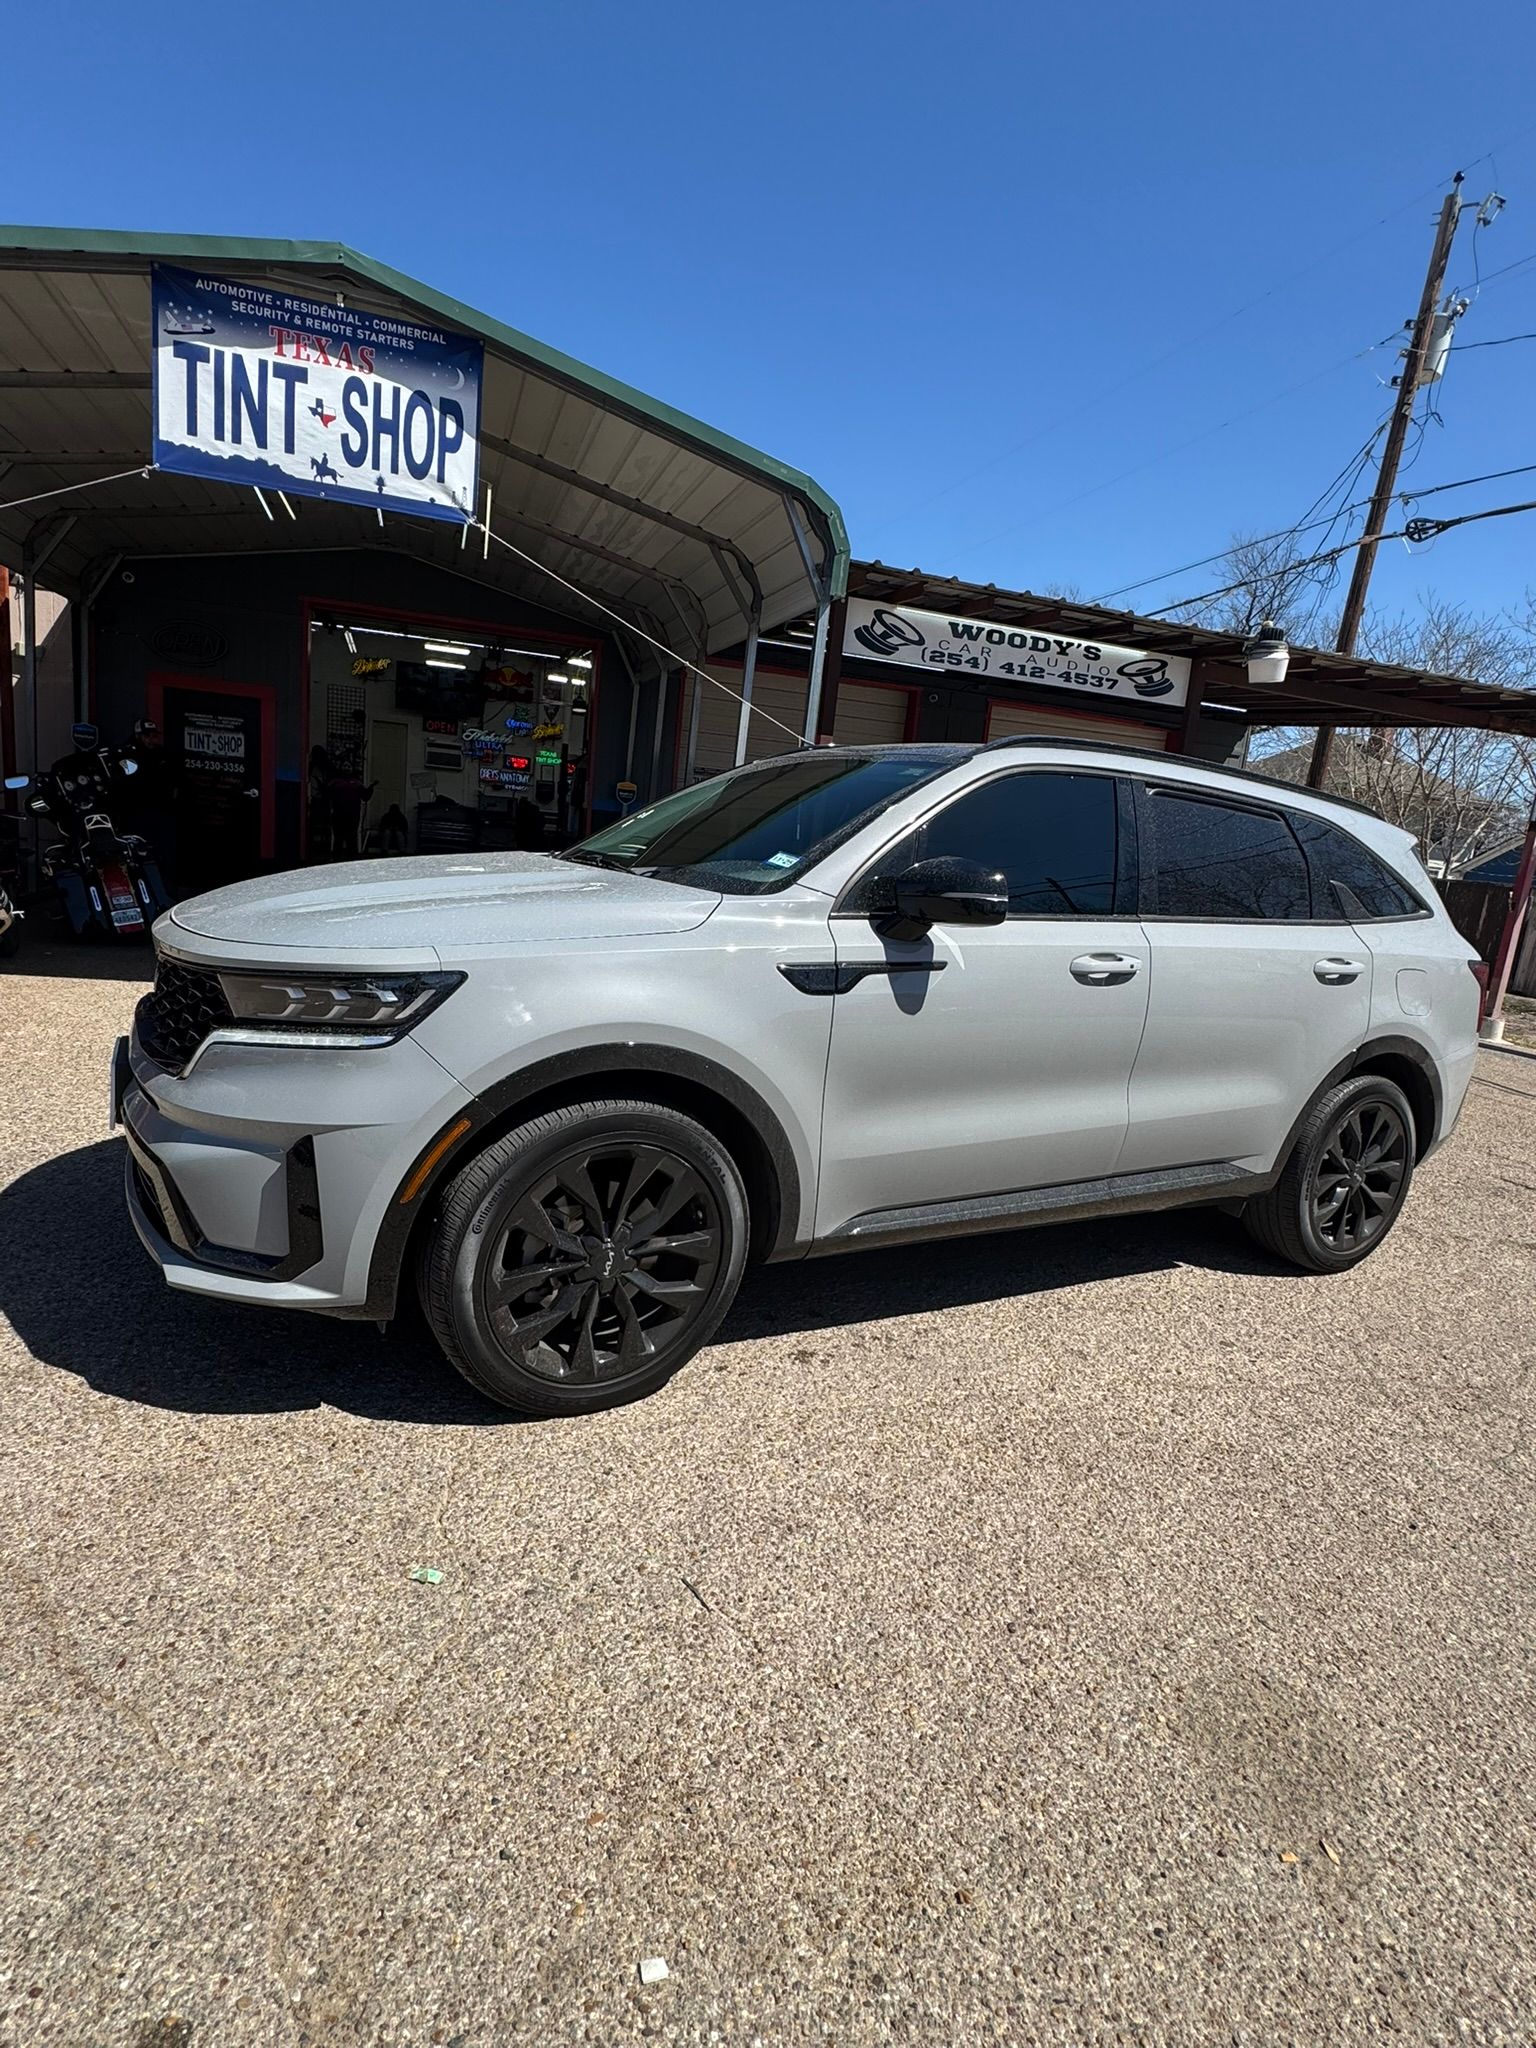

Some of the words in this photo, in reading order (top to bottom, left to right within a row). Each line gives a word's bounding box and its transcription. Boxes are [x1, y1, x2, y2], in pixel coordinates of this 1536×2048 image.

[195, 278, 273, 305] AUTOMOTIVE
[284, 298, 361, 325] RESIDENTIAL
[372, 319, 447, 345] COMMERCIAL
[231, 300, 290, 322] SECURITY
[293, 314, 302, 325] &
[305, 316, 353, 337] REMOTE
[356, 329, 415, 350] STARTERS
[268, 325, 376, 375] TEXAS
[172, 339, 309, 455] TINT
[340, 375, 465, 484] SHOP
[939, 639, 993, 659] CAR
[1025, 654, 1111, 676] AUDIO
[948, 621, 1102, 662] WOODY'S
[920, 646, 990, 672] (254)
[999, 661, 1120, 690] 412-4537
[187, 733, 213, 750] TINT
[217, 735, 243, 753] SHOP
[425, 720, 456, 733] OPEN
[184, 758, 246, 774] 254-230-3356
